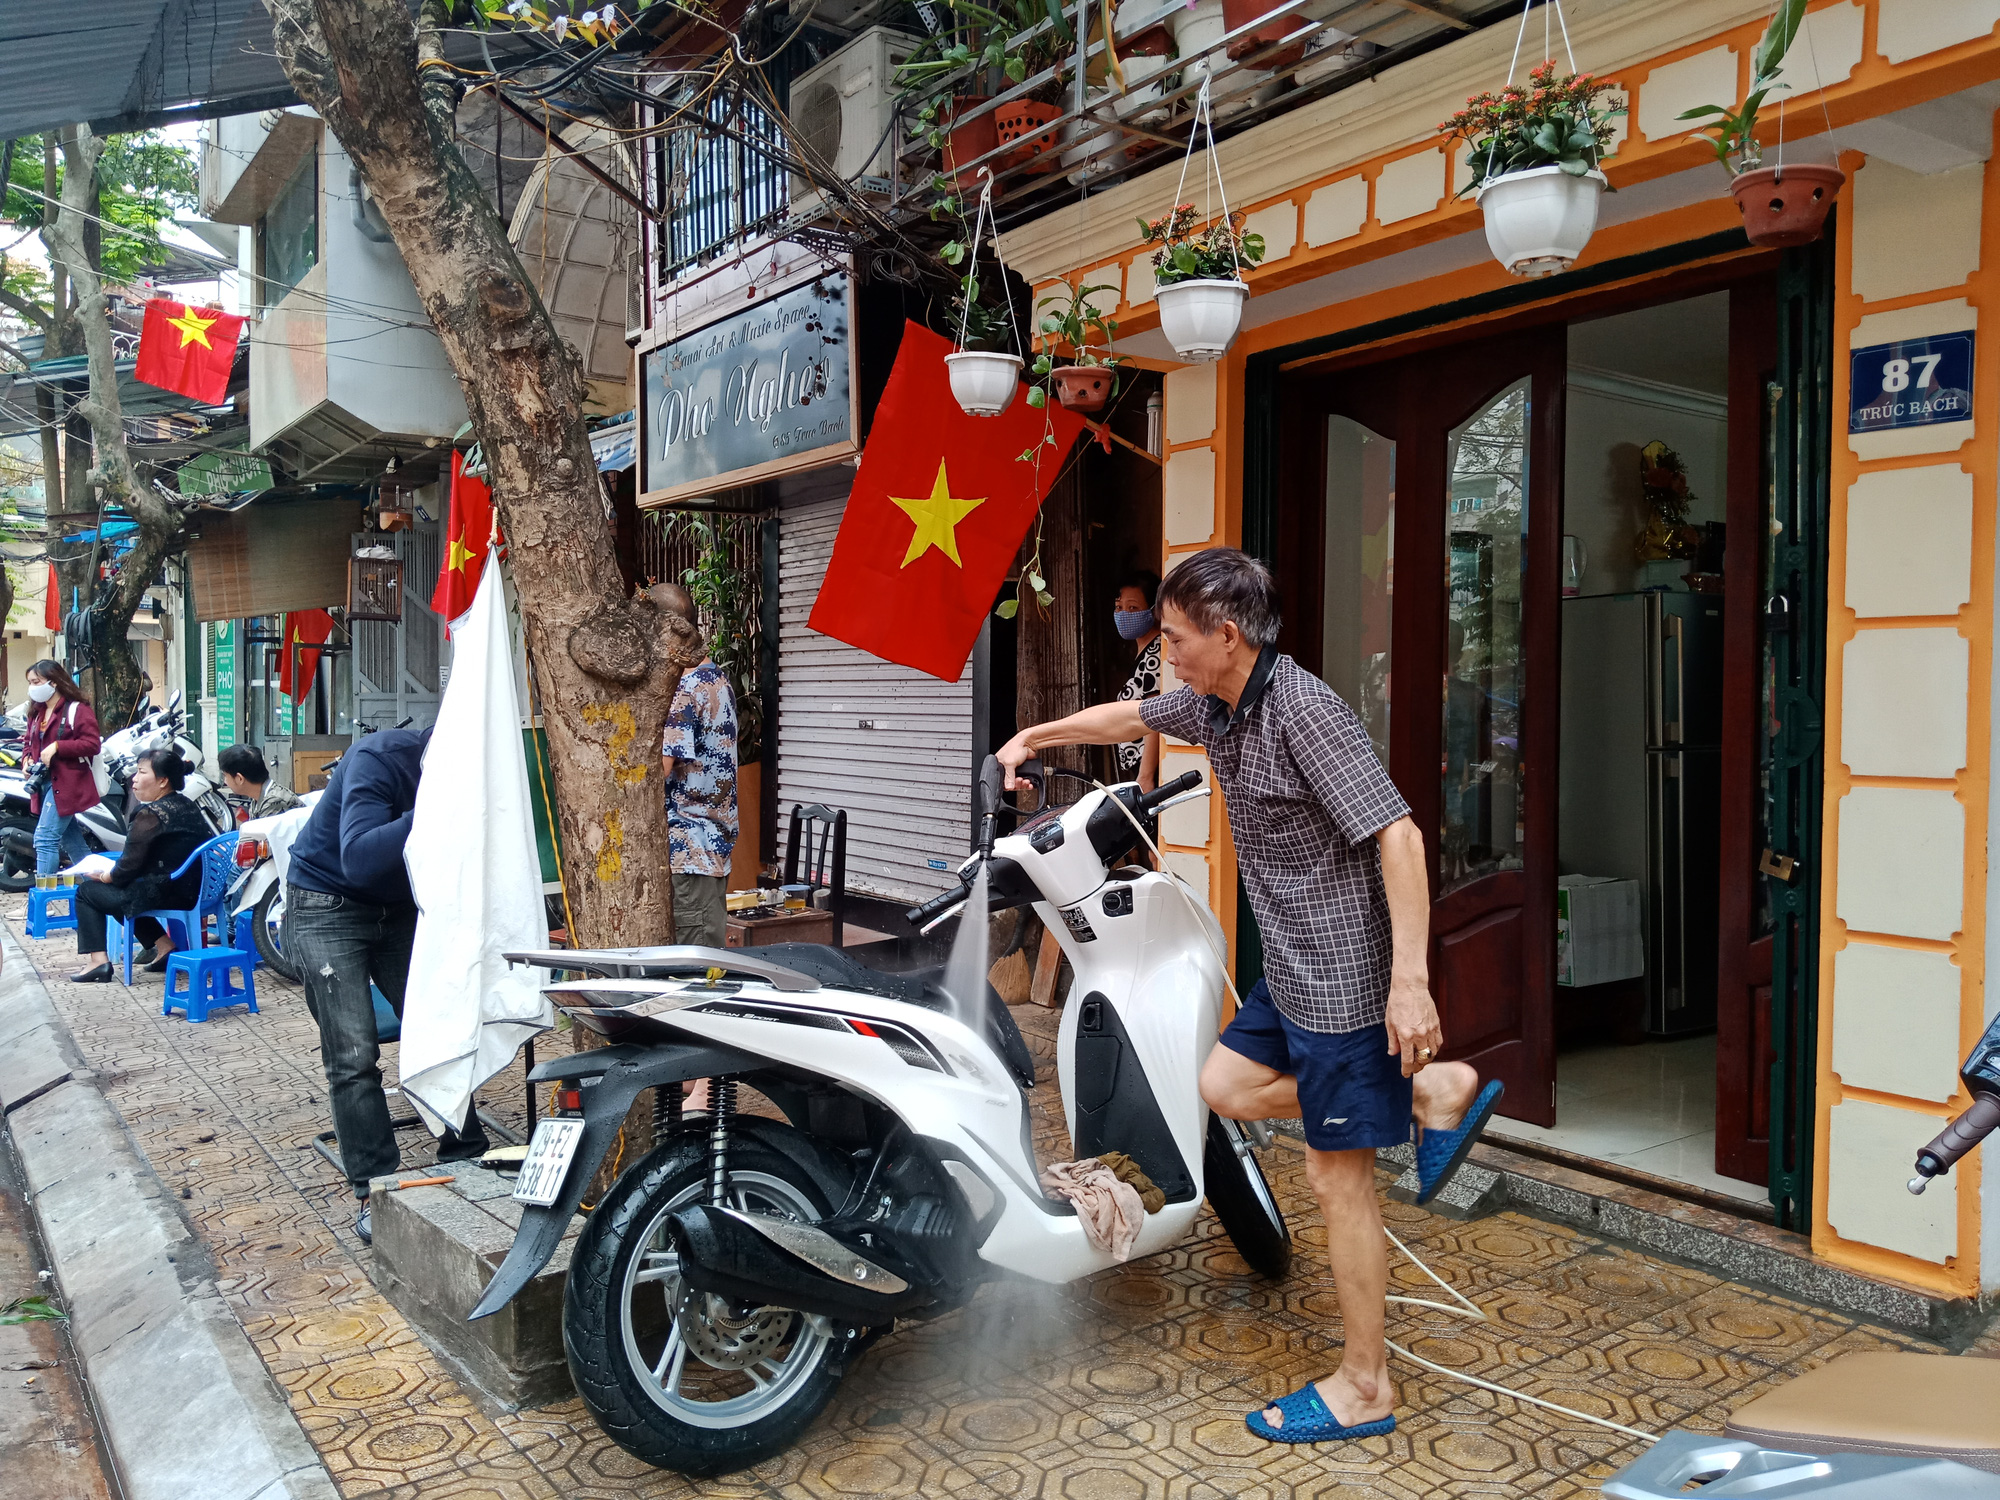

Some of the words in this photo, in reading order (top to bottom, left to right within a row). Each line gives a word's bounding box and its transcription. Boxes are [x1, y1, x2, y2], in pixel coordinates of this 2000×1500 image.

[705, 335, 725, 360] Art
[738, 317, 772, 346] Music
[774, 305, 810, 333] Space
[1882, 353, 1942, 393] 87
[658, 383, 717, 461] Pho
[1859, 401, 1905, 421] TRÚC
[1909, 396, 1959, 417] BẠCH
